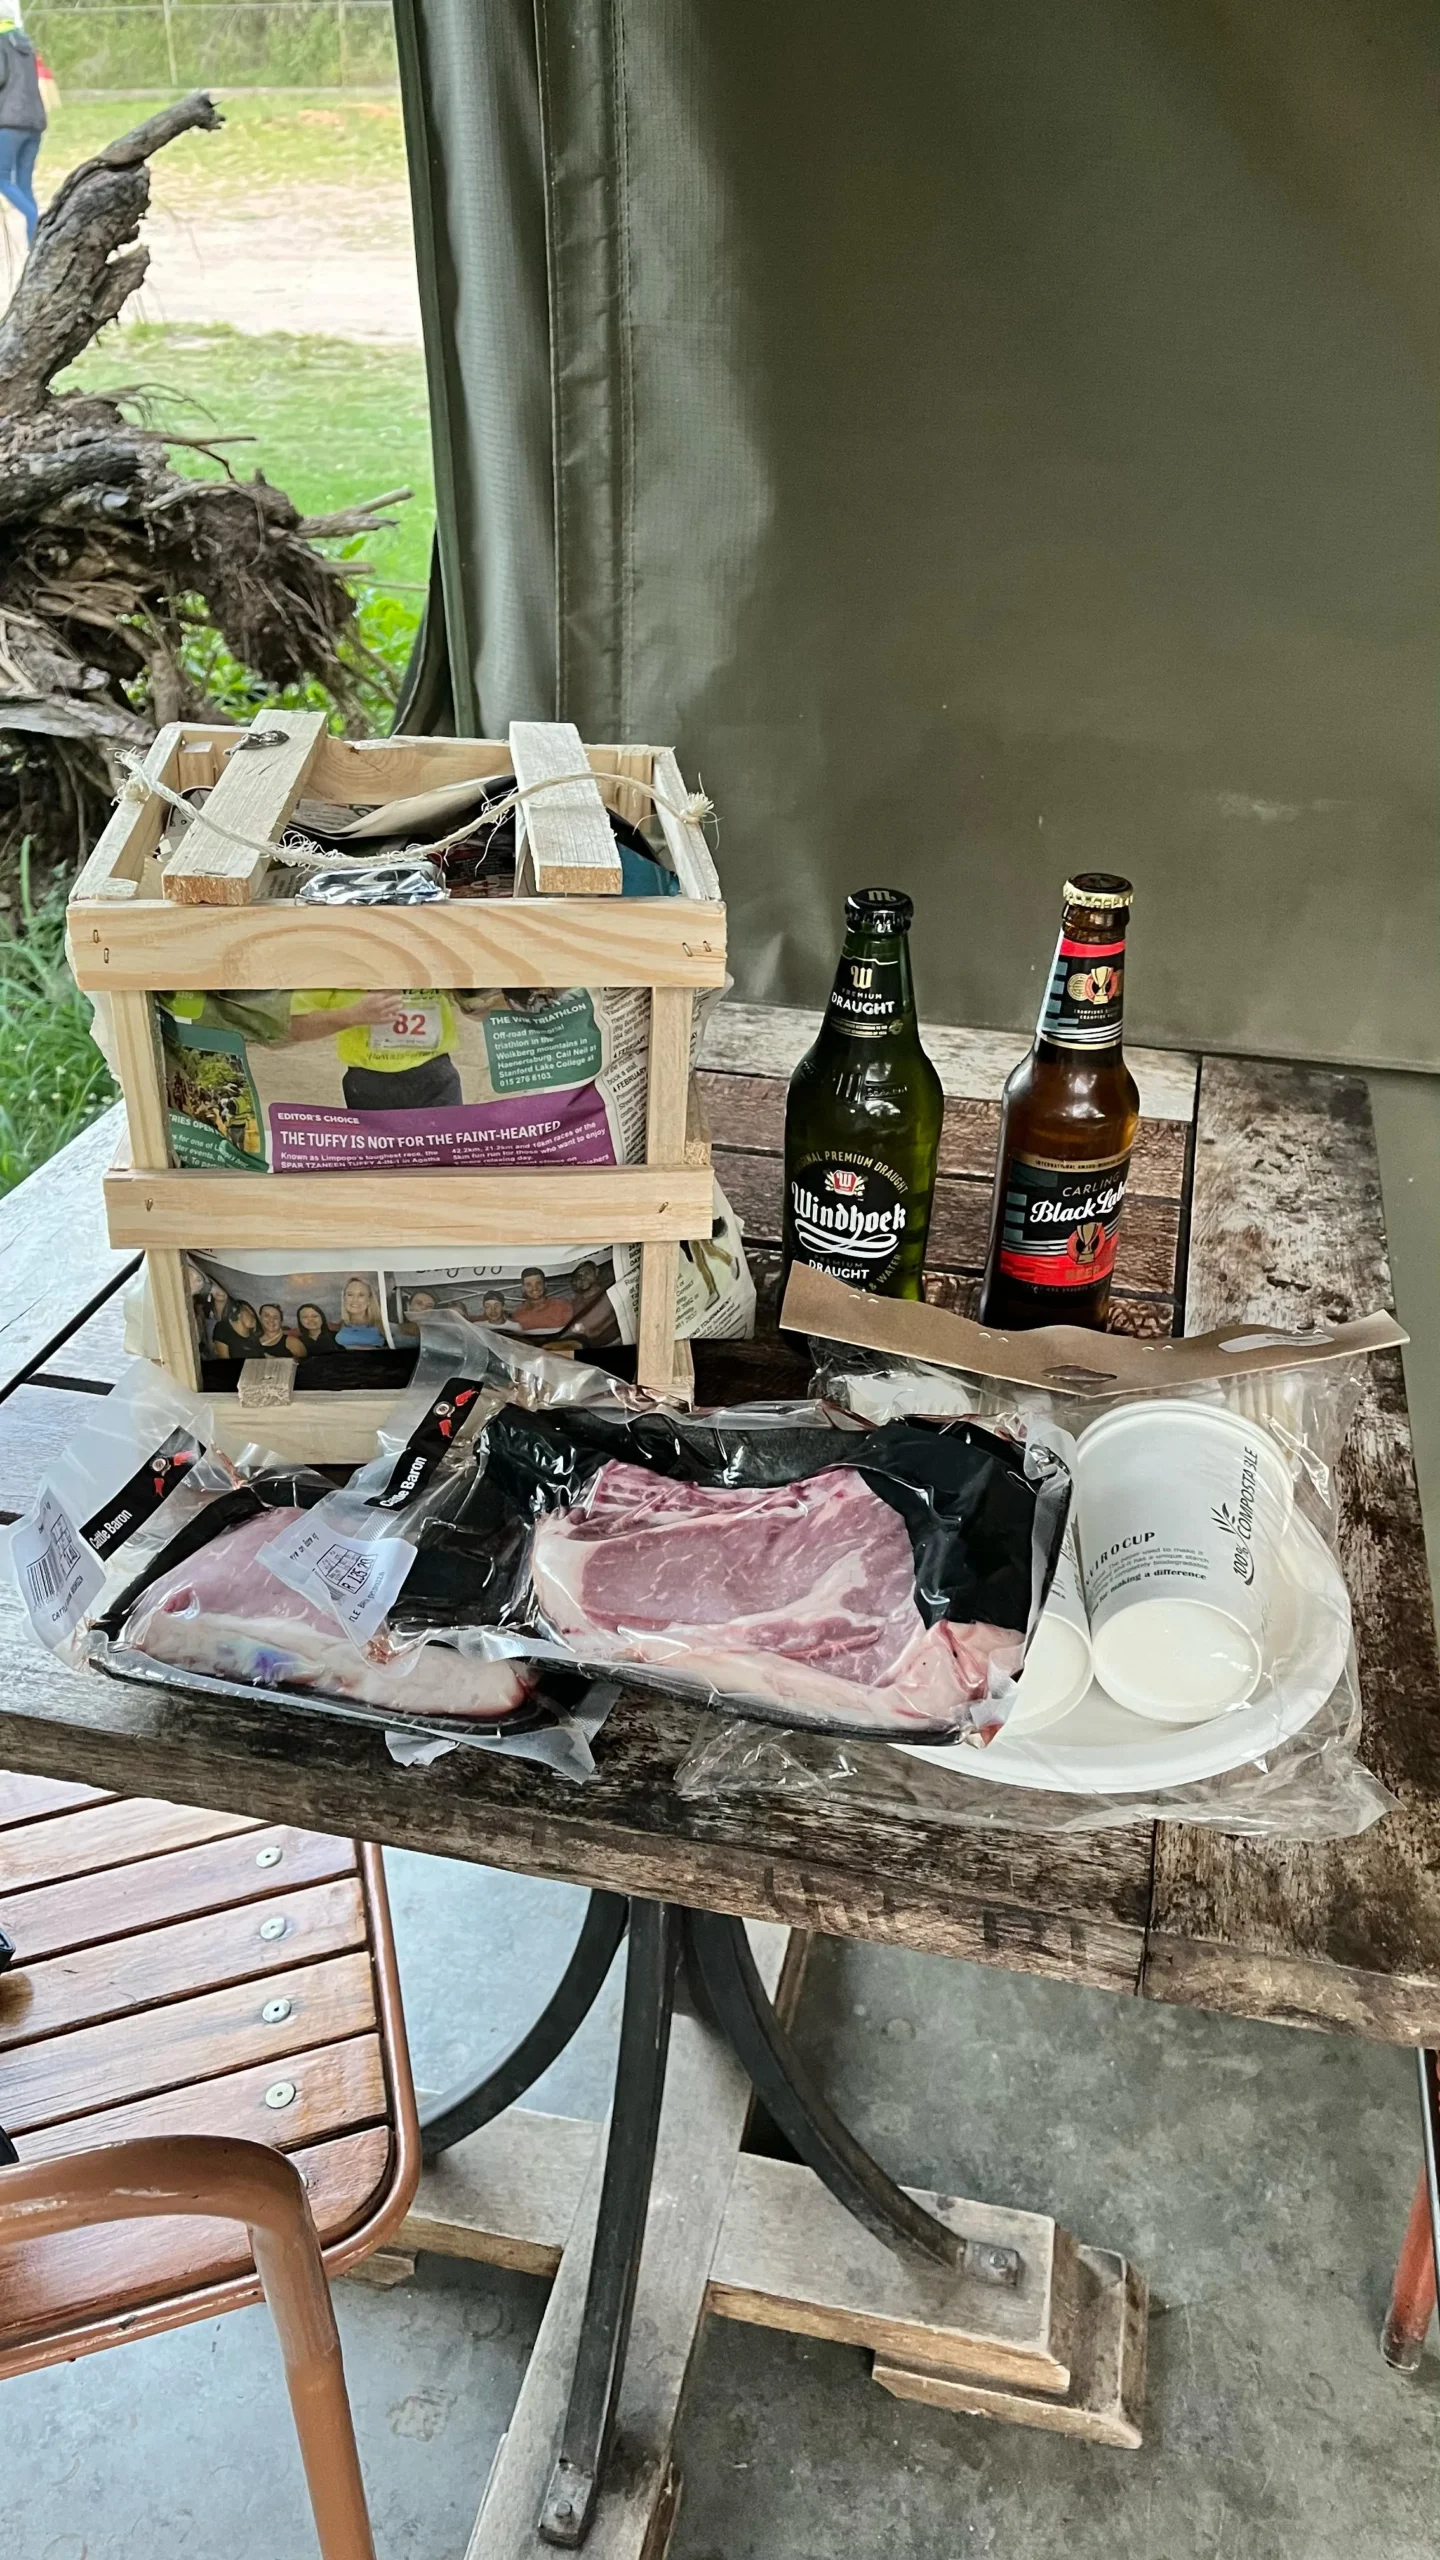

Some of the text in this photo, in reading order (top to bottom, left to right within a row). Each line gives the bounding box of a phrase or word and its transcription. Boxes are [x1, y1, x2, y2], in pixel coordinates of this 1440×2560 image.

[850, 965, 873, 989] W
[831, 991, 895, 1015] DRAUGHT
[841, 987, 882, 1000] PREMIUM
[392, 1013, 426, 1035] 82
[490, 1016, 511, 1026] THE
[534, 1003, 587, 1025] TRIATHLON
[493, 1028, 527, 1040] Off-road
[494, 1039, 529, 1050] triathlon
[496, 1048, 535, 1061] Wolkberg
[536, 1041, 578, 1053] mountains
[555, 1049, 572, 1059] Call
[573, 1046, 588, 1056] Neil
[589, 1044, 597, 1052] at
[499, 1054, 595, 1079] Stanford Lake College at
[500, 1077, 514, 1087] 015
[515, 1074, 530, 1084] 276
[277, 1112, 360, 1125] EDITOR'S CHOICE
[178, 1134, 190, 1144] for
[190, 1138, 204, 1148] one
[205, 1142, 214, 1150] of
[280, 1120, 561, 1149] THE TUFFY IS NOT FOR THE FAINT-HEARTED
[515, 1142, 530, 1150] and
[532, 1138, 553, 1149] 10km
[553, 1130, 574, 1142] races
[583, 1122, 596, 1131] the
[540, 1145, 557, 1154] who
[557, 1138, 576, 1149] want
[576, 1135, 585, 1143] to
[585, 1128, 606, 1140] enjoy
[191, 1158, 201, 1167] To
[280, 1151, 308, 1160] Known
[321, 1154, 364, 1163] Limpopo's
[365, 1153, 402, 1161] toughest
[281, 1161, 304, 1169] SPAR
[412, 1156, 441, 1164] Agatha
[824, 1150, 874, 1168] PREMIUM
[873, 1161, 909, 1195] DRAUGHT
[836, 1171, 853, 1188] W
[1062, 1171, 1120, 1197] CARLING
[791, 1181, 907, 1236] Windhoek
[1029, 1180, 1127, 1223] Black Lab
[808, 1259, 870, 1280] DRAUGHT
[814, 1254, 864, 1268] PREMIUM
[868, 1253, 903, 1291] & WATER
[399, 1456, 428, 1490] Baron
[1232, 1446, 1258, 1579] 100% COMPOSTABLE
[89, 1509, 133, 1550] Cattle Baron
[1142, 1547, 1161, 1555] used
[1173, 1547, 1196, 1555] make
[1155, 1553, 1183, 1561] unique
[1185, 1554, 1210, 1564] starch
[1110, 1573, 1142, 1593] making
[1153, 1568, 1207, 1580] difference
